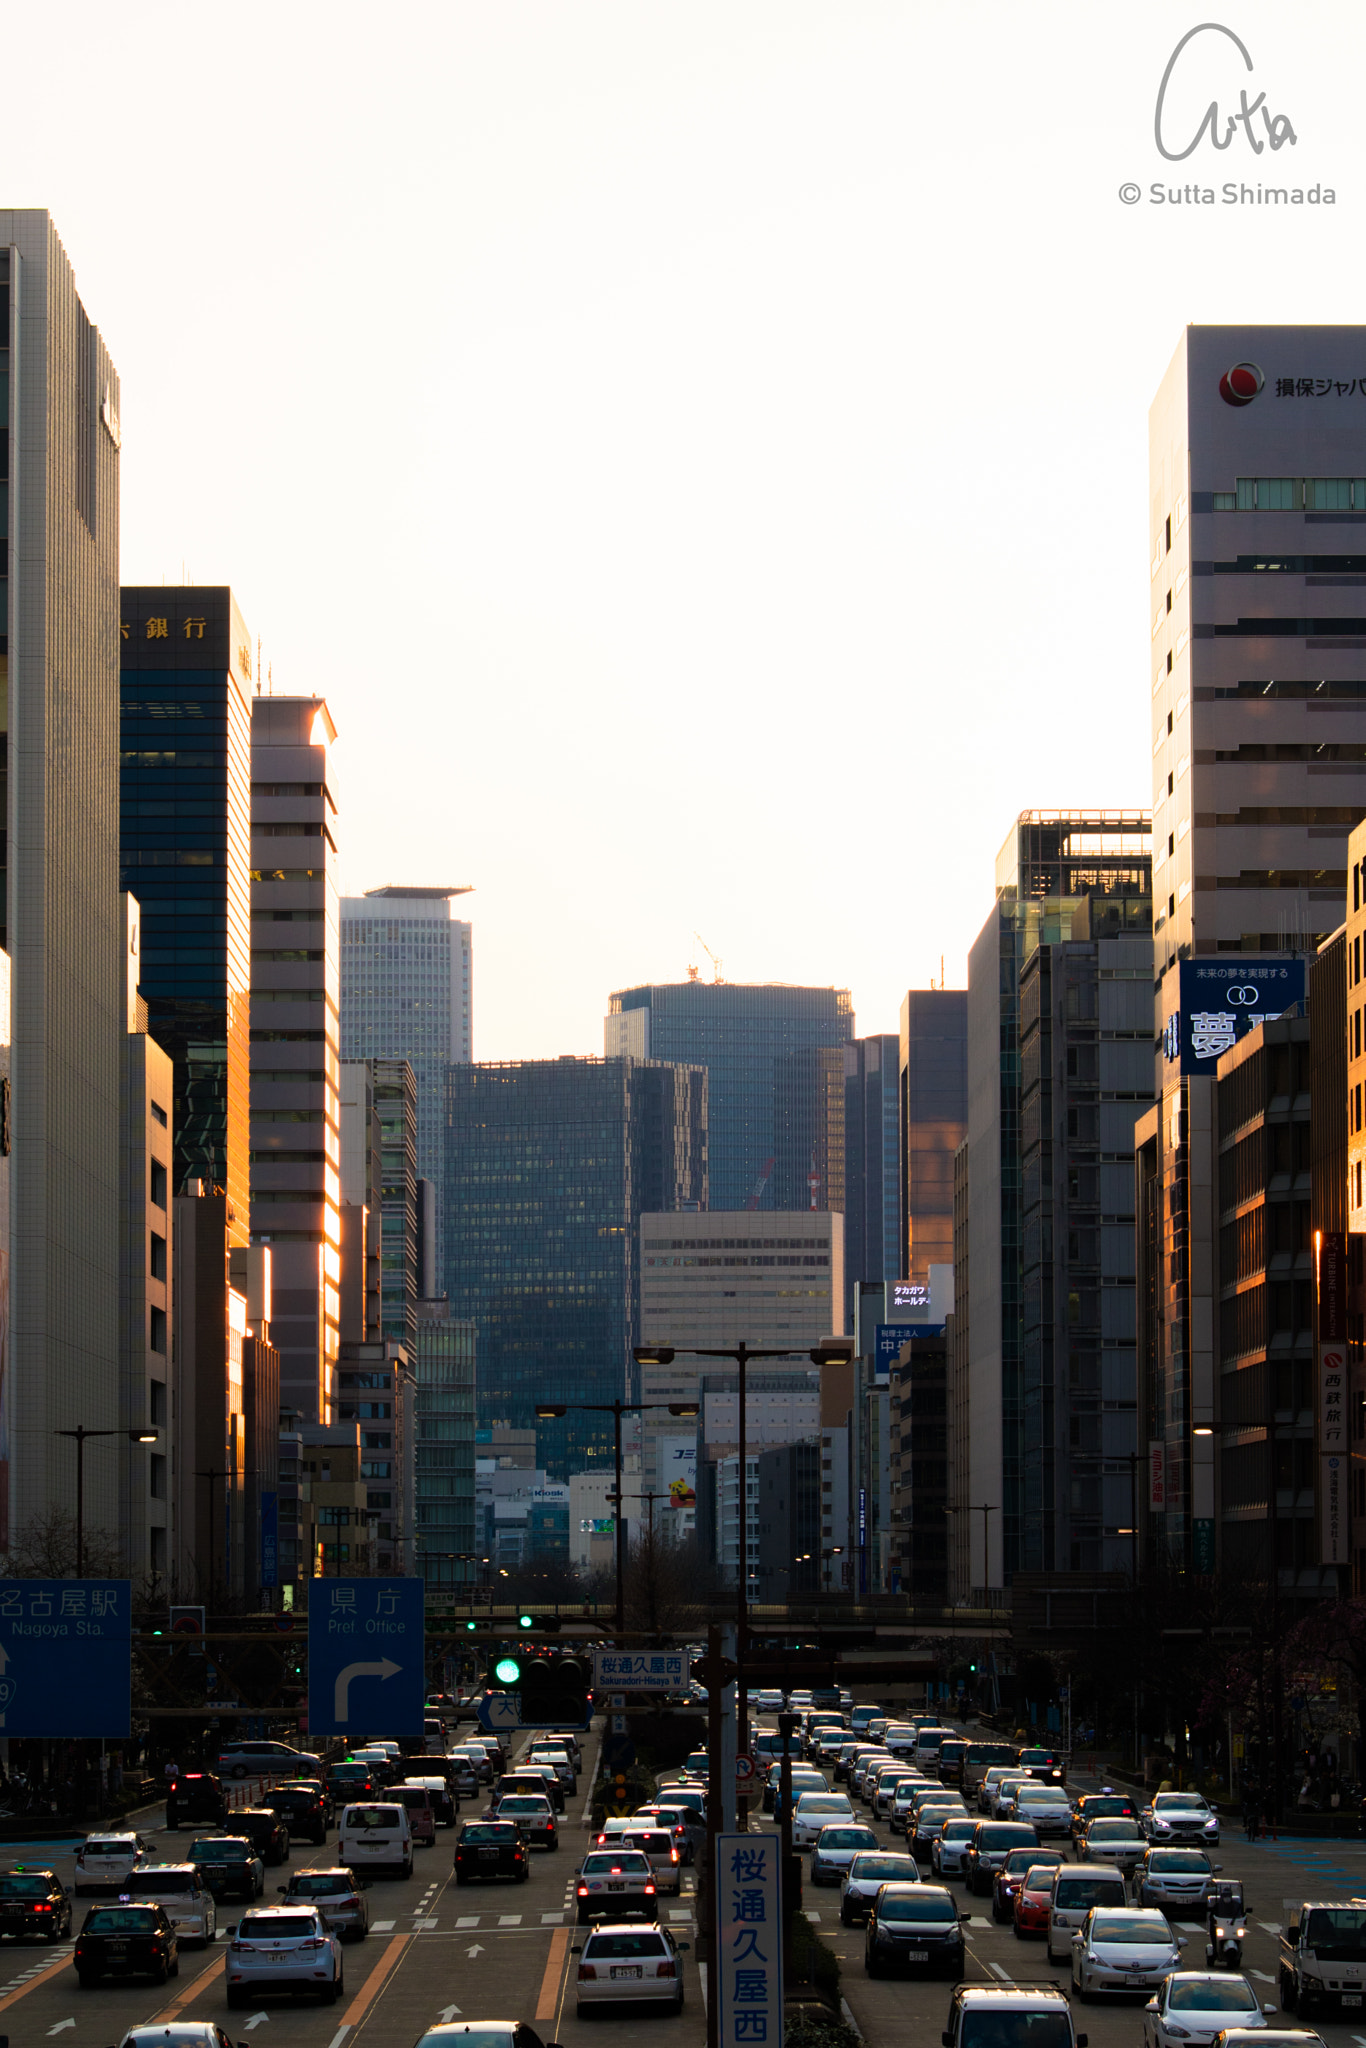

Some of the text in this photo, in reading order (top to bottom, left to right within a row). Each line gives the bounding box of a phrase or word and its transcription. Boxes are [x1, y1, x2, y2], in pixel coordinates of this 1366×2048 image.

[1196, 968, 1288, 979] 未来の夢を実現する
[1327, 1252, 1337, 1291] TURBINE
[881, 1329, 918, 1338] 税理士法人
[534, 1489, 563, 1497] Kiosk
[0, 1589, 118, 1616] 名古屋駅
[329, 1587, 402, 1615] 県庁
[12, 1620, 105, 1638] Nagoya Sta.
[328, 1619, 406, 1634] Pref. Office
[601, 1656, 682, 1674] 桜通久屋西
[600, 1675, 670, 1687] Sakuradori-Hisaya
[731, 1848, 768, 2042] 桜通久屋西
